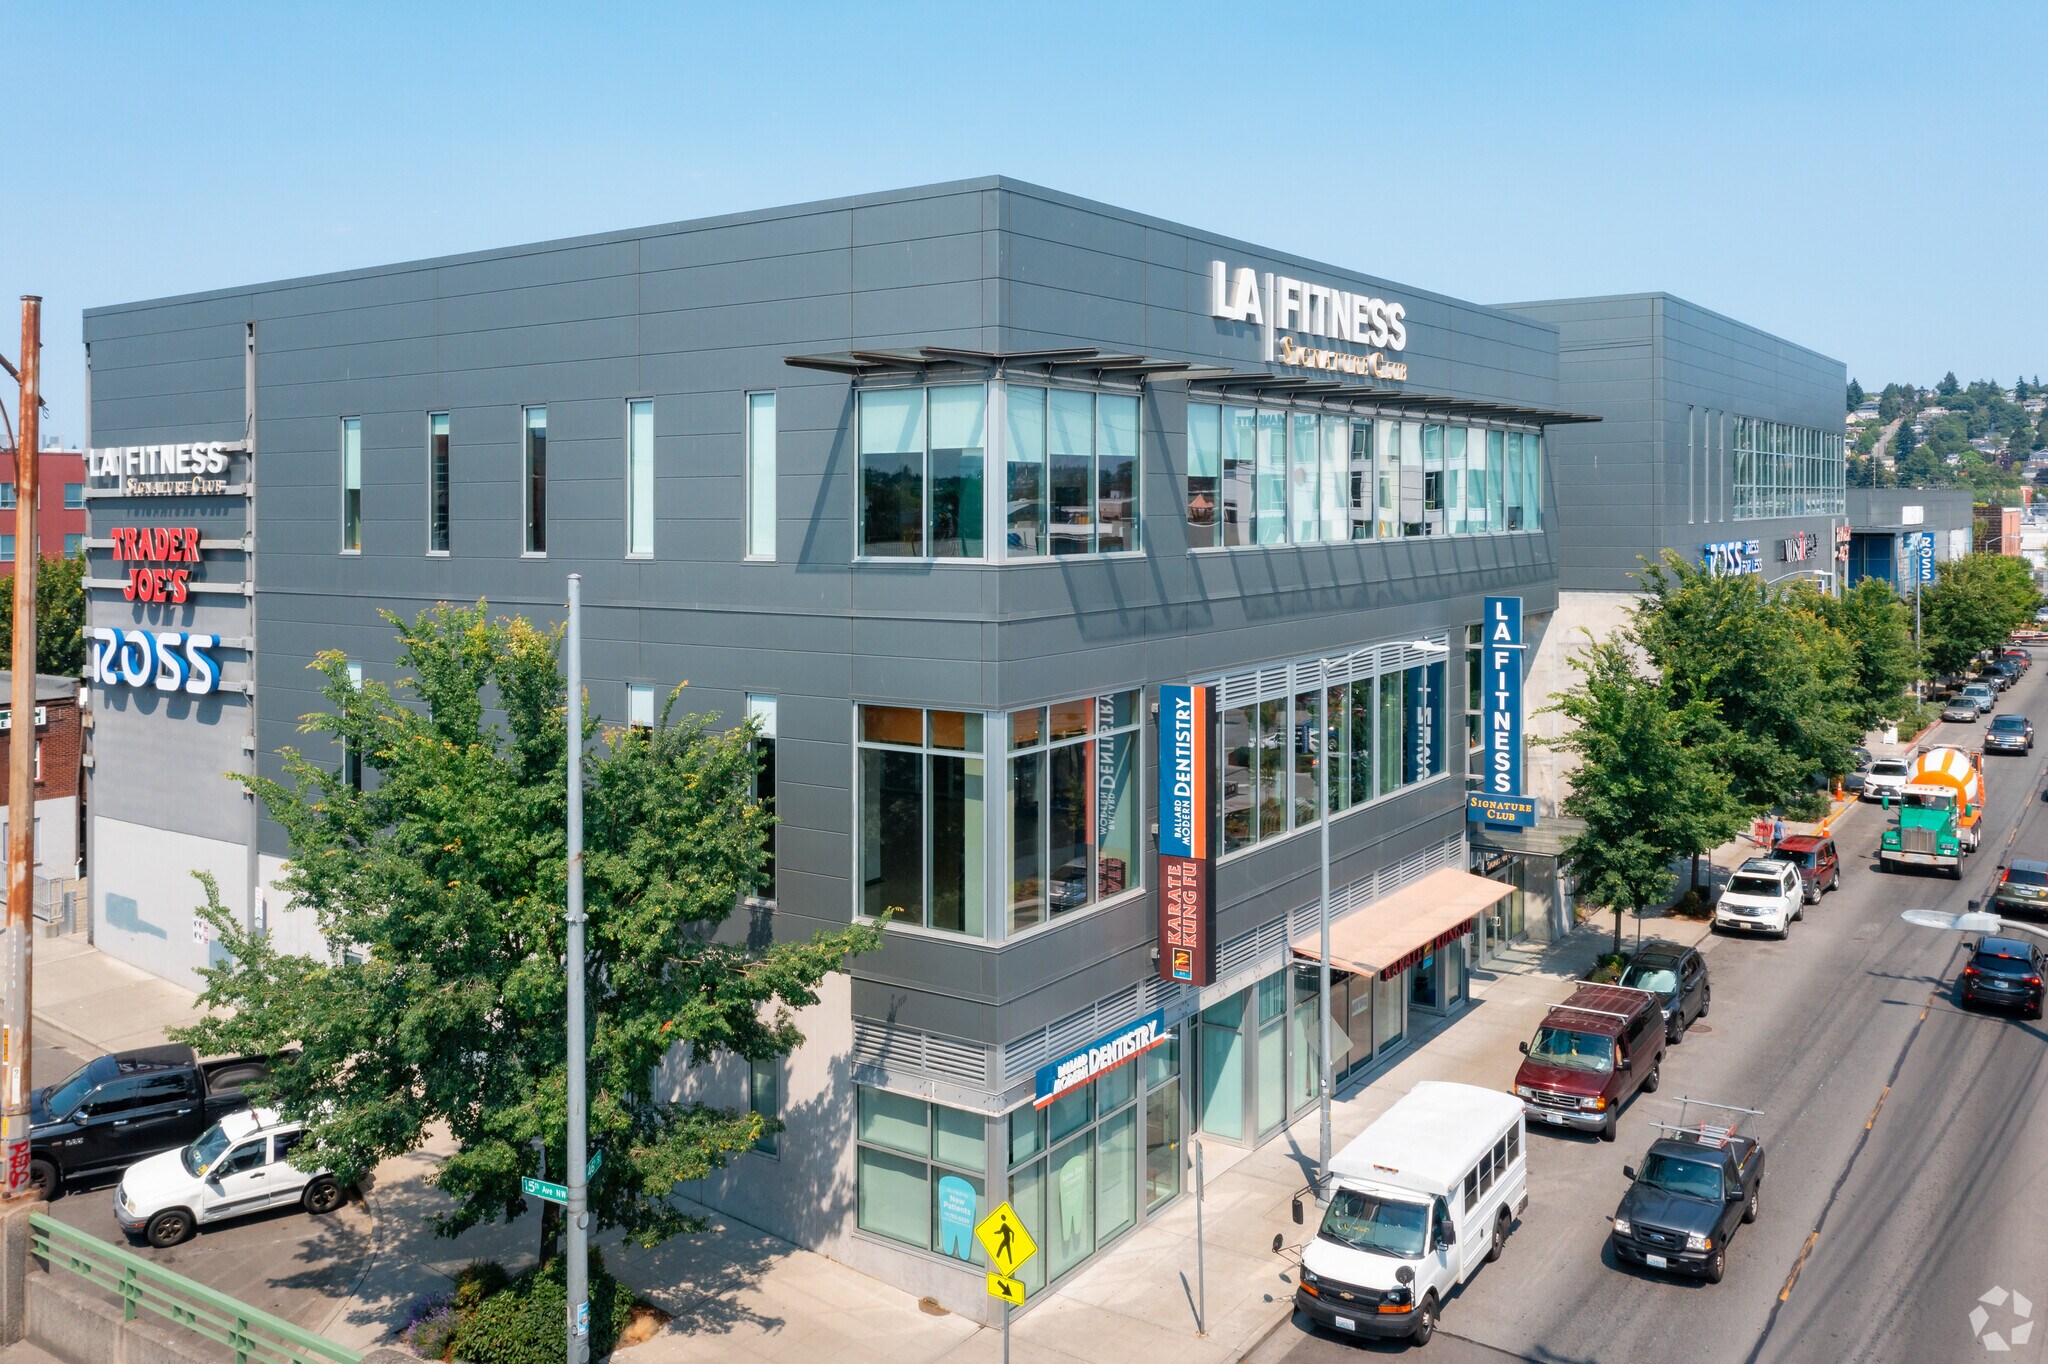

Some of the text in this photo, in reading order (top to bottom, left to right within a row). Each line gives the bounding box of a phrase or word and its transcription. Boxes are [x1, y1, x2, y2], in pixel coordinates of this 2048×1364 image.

[1212, 260, 1407, 351] LA FITNESS
[89, 441, 227, 476] LA FITNESS
[112, 528, 201, 562] TRADER
[1706, 541, 1741, 579] ROSS
[1921, 537, 1932, 580] ROSS
[123, 568, 190, 604] JOE'S
[94, 627, 220, 695] ROSS
[1494, 651, 1511, 793] FITNESS
[1174, 697, 1191, 797] DENTISTRY
[1174, 799, 1182, 838] BALLARD
[1182, 801, 1191, 846] MODERN
[1486, 809, 1515, 821] CLUB
[1168, 865, 1181, 945] KARATE
[1183, 862, 1197, 948] KUNG FU
[1089, 1020, 1157, 1075] DENTISTRY
[525, 1180, 566, 1199] 15th Ave NW
